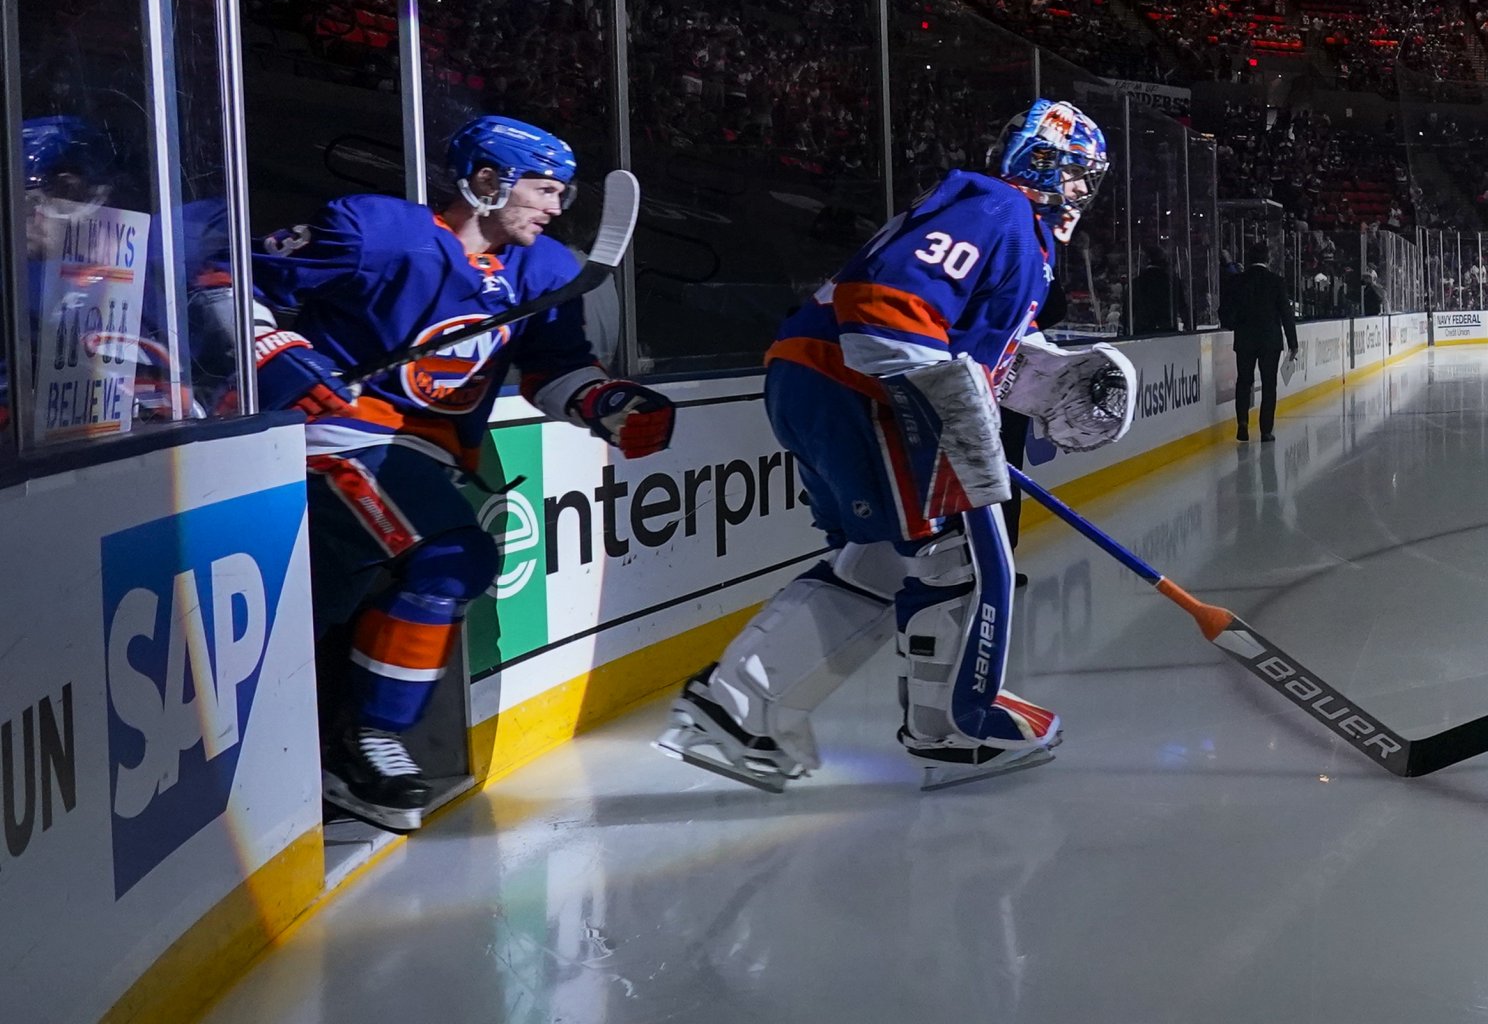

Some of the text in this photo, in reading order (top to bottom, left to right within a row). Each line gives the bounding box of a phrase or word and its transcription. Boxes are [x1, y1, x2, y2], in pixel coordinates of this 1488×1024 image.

[61, 217, 137, 269] ALWAYS
[914, 231, 980, 280] 30
[1437, 314, 1481, 325] NAVY FEDERAL
[46, 375, 125, 431] BELIEVE
[478, 451, 811, 599] enterpri
[2, 551, 268, 858] UN SAP
